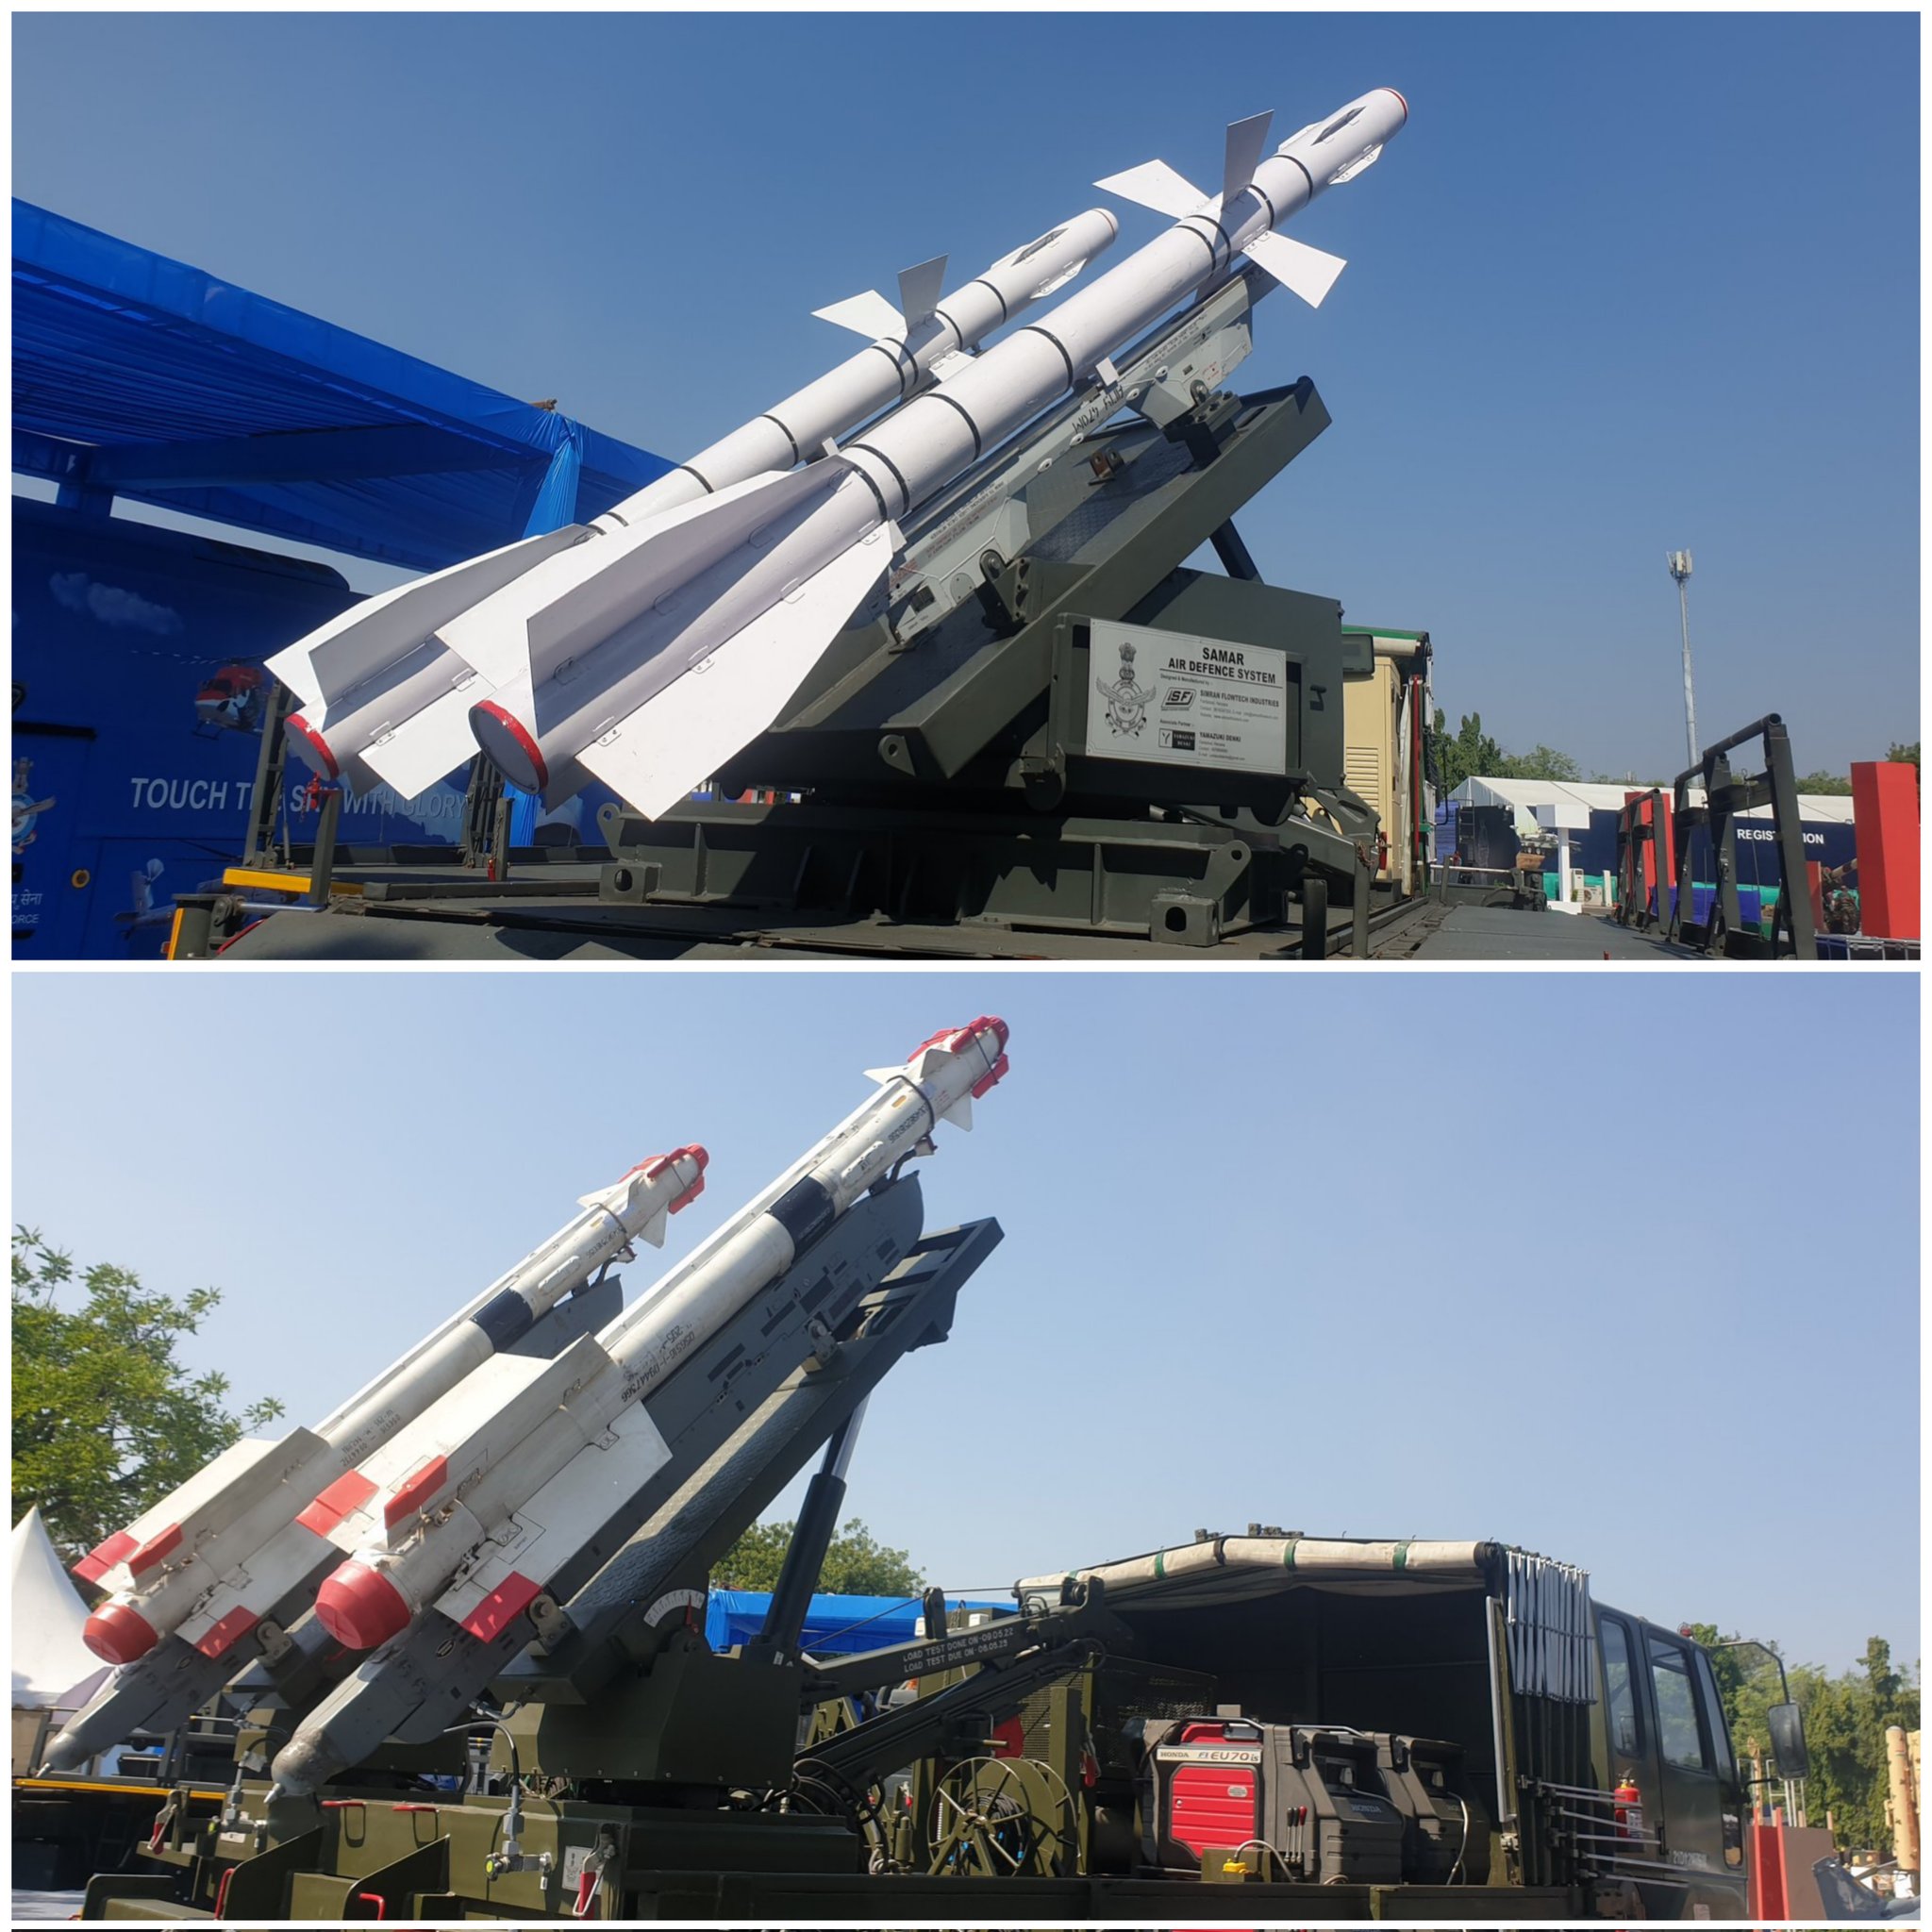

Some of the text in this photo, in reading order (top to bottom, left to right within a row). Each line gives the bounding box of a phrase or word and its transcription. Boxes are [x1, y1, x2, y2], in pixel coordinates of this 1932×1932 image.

[1202, 647, 1244, 666] SAMAR
[1168, 658, 1276, 684] AIR DEFENCE SYSTEM
[1200, 690, 1221, 699] SIMRAN
[1221, 691, 1249, 703] FLOWTECH
[1249, 695, 1279, 708] INDUSTRIES
[130, 777, 228, 809] TOUCH
[342, 789, 395, 816] WITH
[403, 794, 466, 818] GLORY
[1736, 828, 1824, 844] REGISION
[903, 1649, 923, 1661] LOAD
[925, 1644, 945, 1656] TEST
[946, 1639, 967, 1651] DONE
[904, 1661, 924, 1673] LOAD
[926, 1655, 946, 1667] TEST
[948, 1650, 962, 1661] DUE
